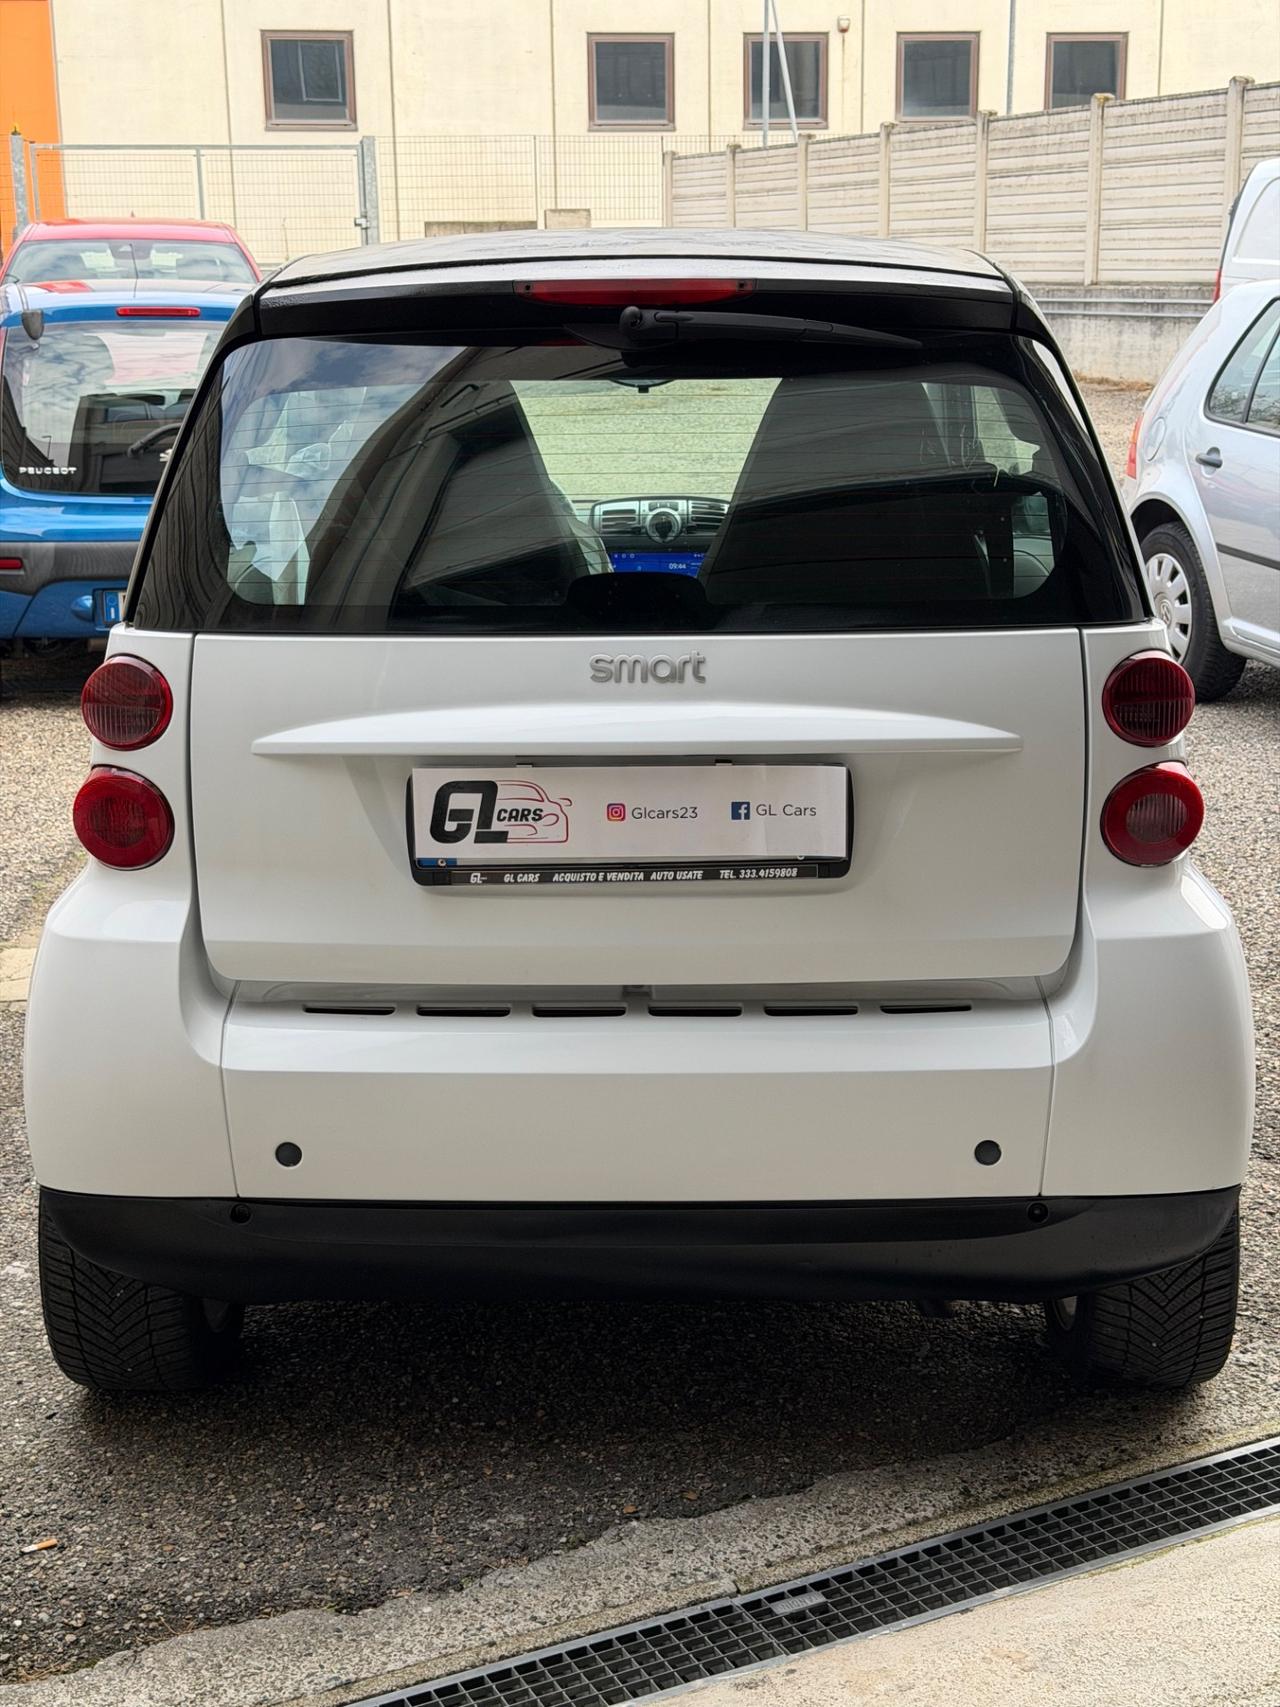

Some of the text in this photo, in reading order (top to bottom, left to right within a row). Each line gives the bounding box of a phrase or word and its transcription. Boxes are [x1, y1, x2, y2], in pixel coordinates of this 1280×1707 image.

[18, 466, 77, 475] PEUGEOT
[589, 650, 706, 683] smart
[430, 780, 544, 844] GL CARS
[755, 804, 817, 817] GL Cars
[503, 867, 798, 883] GL CARS ACQUISTO E VENDITA AUTO USATE TEL. 333.4159808
